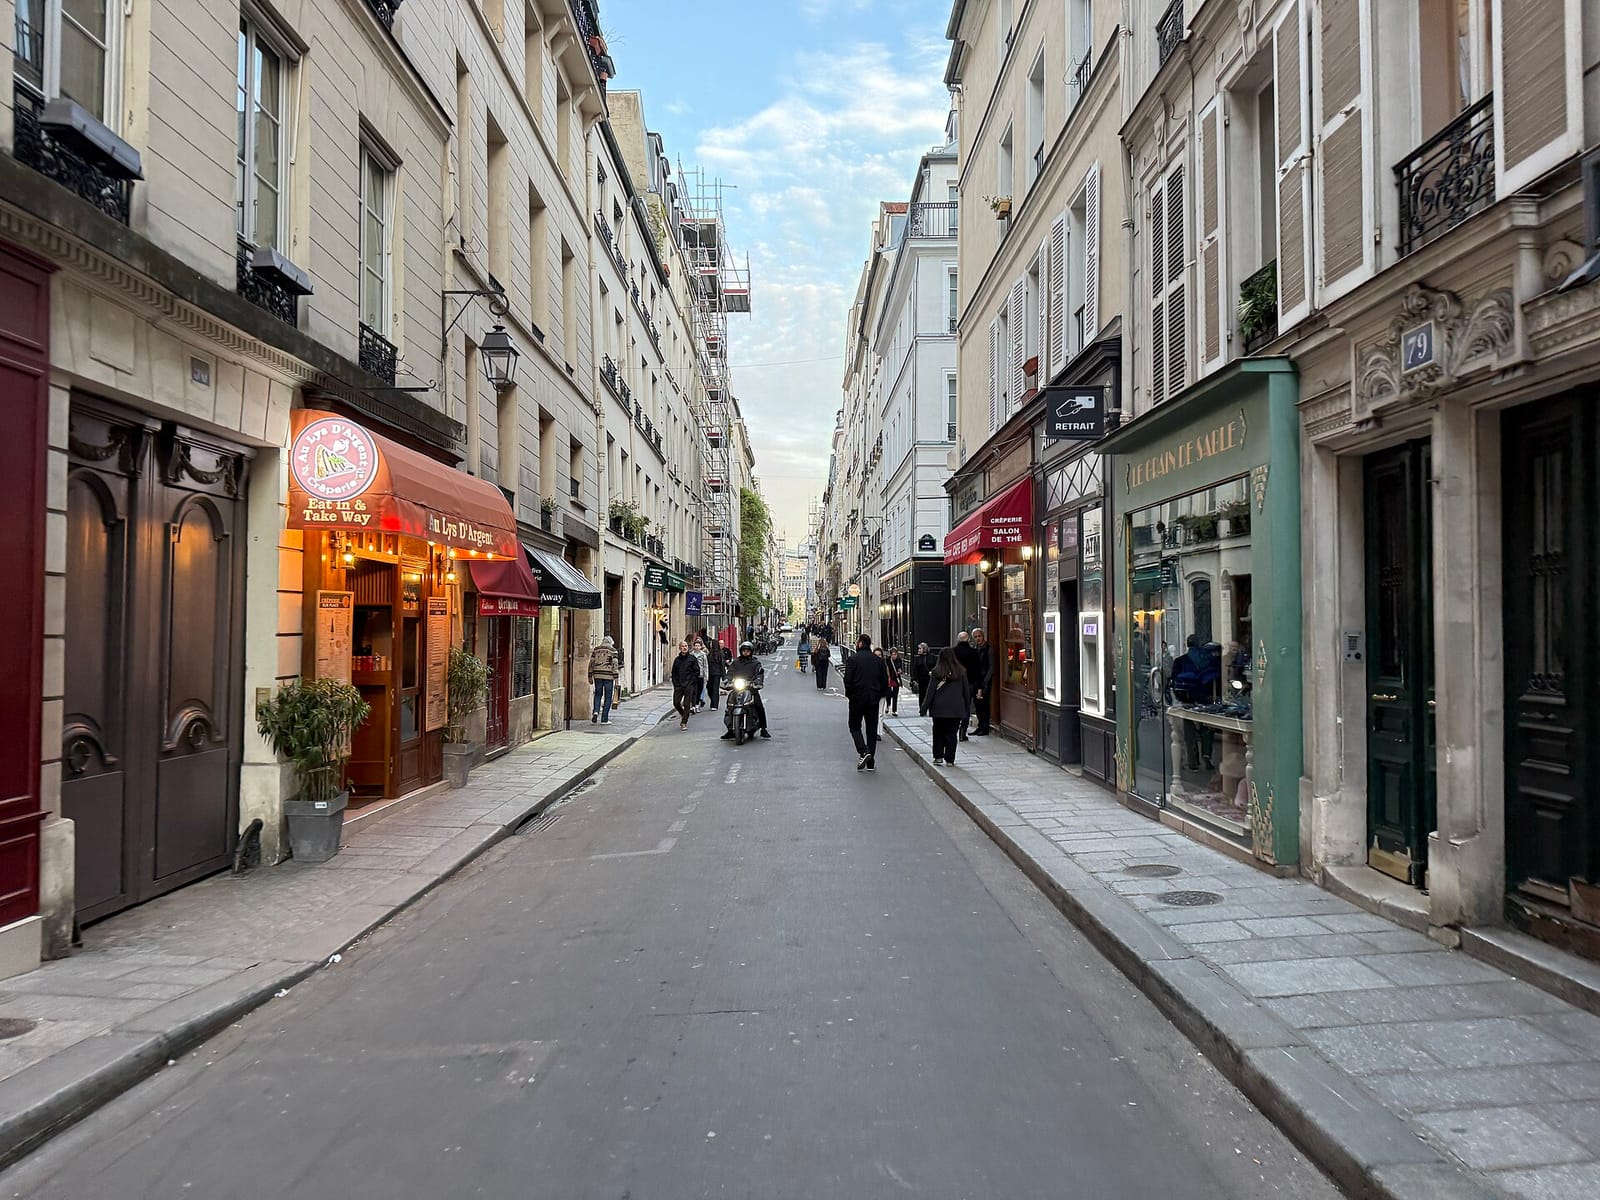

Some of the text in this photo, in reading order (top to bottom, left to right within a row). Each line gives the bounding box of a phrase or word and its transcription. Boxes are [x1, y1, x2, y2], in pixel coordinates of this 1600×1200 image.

[1407, 332, 1427, 364] 79
[1055, 421, 1095, 431] RETRAIT
[297, 445, 310, 463] Au
[305, 427, 329, 444] Lys
[1132, 464, 1143, 488] LE
[307, 498, 332, 509] Eat
[354, 499, 367, 511] &
[303, 509, 371, 525] Take Way
[990, 516, 1023, 524] CRÊPERIE
[429, 513, 494, 547] Au Lys D'Argent
[993, 527, 1020, 535] SALON
[1006, 534, 1023, 542] THÉ
[540, 592, 563, 603] Away
